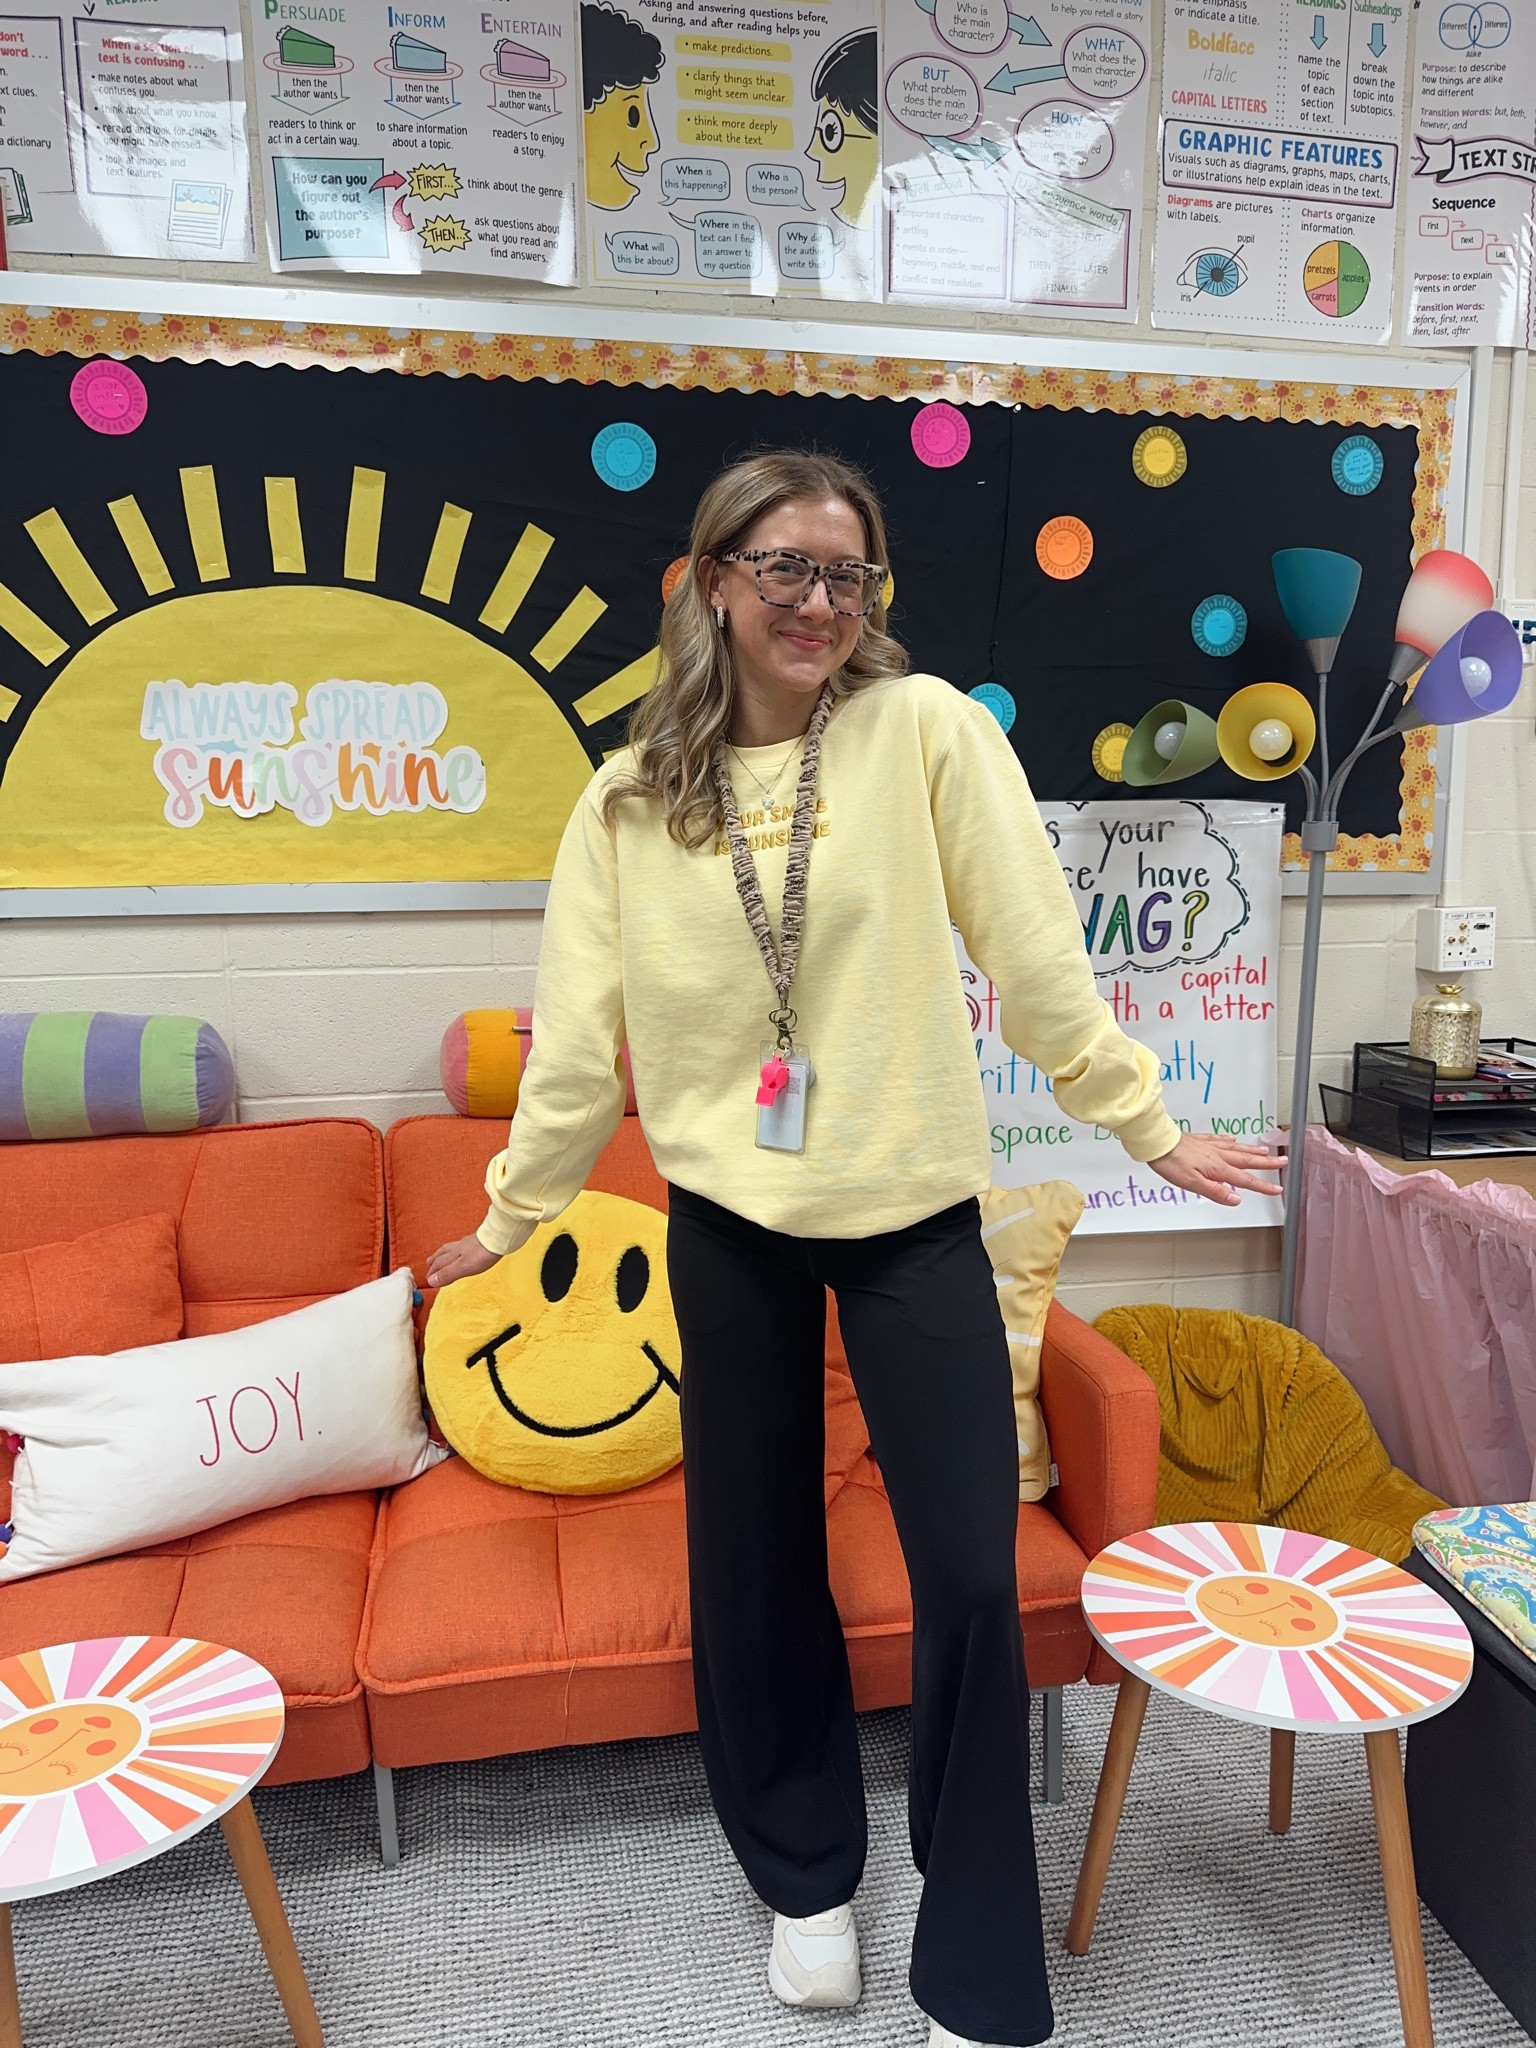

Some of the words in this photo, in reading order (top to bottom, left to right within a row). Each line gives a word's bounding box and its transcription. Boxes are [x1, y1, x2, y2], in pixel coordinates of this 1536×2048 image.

[265, 0, 346, 22] PERSUADE
[388, 6, 445, 28] INFORM
[677, 0, 694, 10] and
[698, 4, 745, 20] answering
[750, 9, 793, 19] questions
[798, 10, 828, 24] before,
[481, 13, 561, 38] ENTERTAIN
[652, 12, 685, 27] during,
[690, 16, 707, 26] and
[711, 18, 733, 28] after
[738, 21, 772, 35] reading
[776, 23, 800, 37] helps
[803, 29, 820, 39] you
[693, 40, 717, 51] make
[722, 43, 772, 56] predictions.
[1085, 38, 1125, 52] WHAT
[1188, 29, 1254, 55] Boldface
[98, 53, 119, 63] text
[123, 53, 131, 64] is
[135, 57, 185, 70] confusing
[1072, 51, 1096, 62] What
[1100, 53, 1119, 64] does
[1123, 55, 1136, 65] the
[923, 67, 949, 82] BUT
[1072, 64, 1092, 73] main
[1095, 65, 1136, 77] character
[1203, 62, 1237, 83] italic
[1422, 63, 1456, 73] Purpose:
[1470, 64, 1506, 72] describe
[98, 73, 121, 82] make
[124, 75, 147, 84] notes
[150, 76, 174, 85] about
[177, 78, 198, 87] what
[293, 78, 311, 86] then
[314, 79, 327, 87] the
[693, 70, 720, 85] clarify
[724, 72, 752, 88] things
[756, 75, 775, 86] that
[1094, 79, 1117, 88] want?
[1422, 75, 1437, 83] how
[1439, 77, 1463, 86] things
[284, 89, 309, 98] author
[313, 91, 337, 99] wants
[695, 86, 722, 100] might
[726, 91, 748, 99] seem
[753, 91, 785, 102] unclear.
[903, 81, 928, 92] What
[929, 85, 966, 100] problem
[904, 94, 924, 105] does
[928, 95, 941, 107] the
[945, 99, 965, 109] main
[1172, 90, 1216, 107] CAPITAL
[1222, 96, 1267, 113] LETTERS
[901, 106, 942, 119] character
[946, 111, 968, 122] face?
[269, 119, 305, 128] readers
[308, 120, 317, 129] to
[320, 120, 343, 129] think
[347, 122, 356, 130] or
[377, 122, 385, 131] to
[388, 123, 413, 132] share
[417, 124, 467, 135] information
[694, 115, 718, 126] think
[749, 119, 777, 134] deeply
[268, 135, 281, 144] act
[296, 136, 301, 144] a
[304, 135, 336, 144] certain
[339, 138, 357, 147] way.
[392, 138, 417, 148] about
[421, 140, 426, 148] a
[430, 139, 451, 150] topic.
[493, 130, 527, 140] readers
[531, 132, 538, 141] to
[542, 133, 564, 147] enjoy
[696, 131, 722, 142] about
[726, 133, 740, 143] the
[745, 135, 763, 145] text.
[522, 146, 543, 158] story.
[1178, 127, 1274, 160] GRAPHIC
[1282, 138, 1385, 171] FEATURES
[1459, 149, 1507, 170] TEXT
[676, 166, 703, 175] When
[705, 167, 712, 176] is
[1169, 153, 1201, 165] Visuals
[1205, 158, 1226, 167] such
[1230, 160, 1240, 168] as
[1244, 160, 1288, 174] diagrams,
[1292, 167, 1326, 179] graphs,
[1330, 171, 1355, 181] maps,
[1359, 173, 1390, 185] charts,
[417, 174, 453, 190] FIRST...
[468, 179, 490, 189] think
[493, 182, 518, 192] about
[521, 184, 535, 194] the
[539, 187, 562, 198] genre.
[665, 179, 679, 188] this
[682, 180, 727, 192] happening?
[1172, 169, 1180, 178] or
[1187, 168, 1242, 184] illustrations
[1246, 176, 1266, 187] help
[1269, 179, 1303, 190] explain
[1306, 183, 1329, 193] ideas
[1333, 184, 1340, 194] in
[1344, 186, 1358, 196] the
[1362, 188, 1379, 198] text.
[1168, 194, 1213, 210] Diagrams
[1216, 201, 1232, 210] are
[1235, 203, 1273, 214] pictures
[1432, 198, 1495, 211] Sequence
[1167, 211, 1187, 220] with
[1190, 212, 1220, 223] labels.
[1302, 208, 1332, 219] Charts
[1336, 213, 1375, 224] organize
[427, 227, 468, 244] THEN...
[1301, 223, 1353, 235] information.
[1237, 235, 1254, 244] pupil
[1307, 266, 1336, 275] pretzels
[1342, 275, 1364, 283] apples
[1311, 293, 1336, 302] carrots
[148, 689, 290, 742] ALWAYS
[306, 689, 441, 743] SPREAD
[161, 742, 484, 821] sunshine
[1099, 819, 1174, 873] your
[1138, 852, 1210, 888] have
[1181, 956, 1267, 1003] capital
[1159, 1005, 1174, 1019] a
[1202, 995, 1274, 1022] letter
[991, 1122, 1073, 1163] space
[1212, 1100, 1274, 1136] words
[196, 1372, 322, 1467] JOY.
